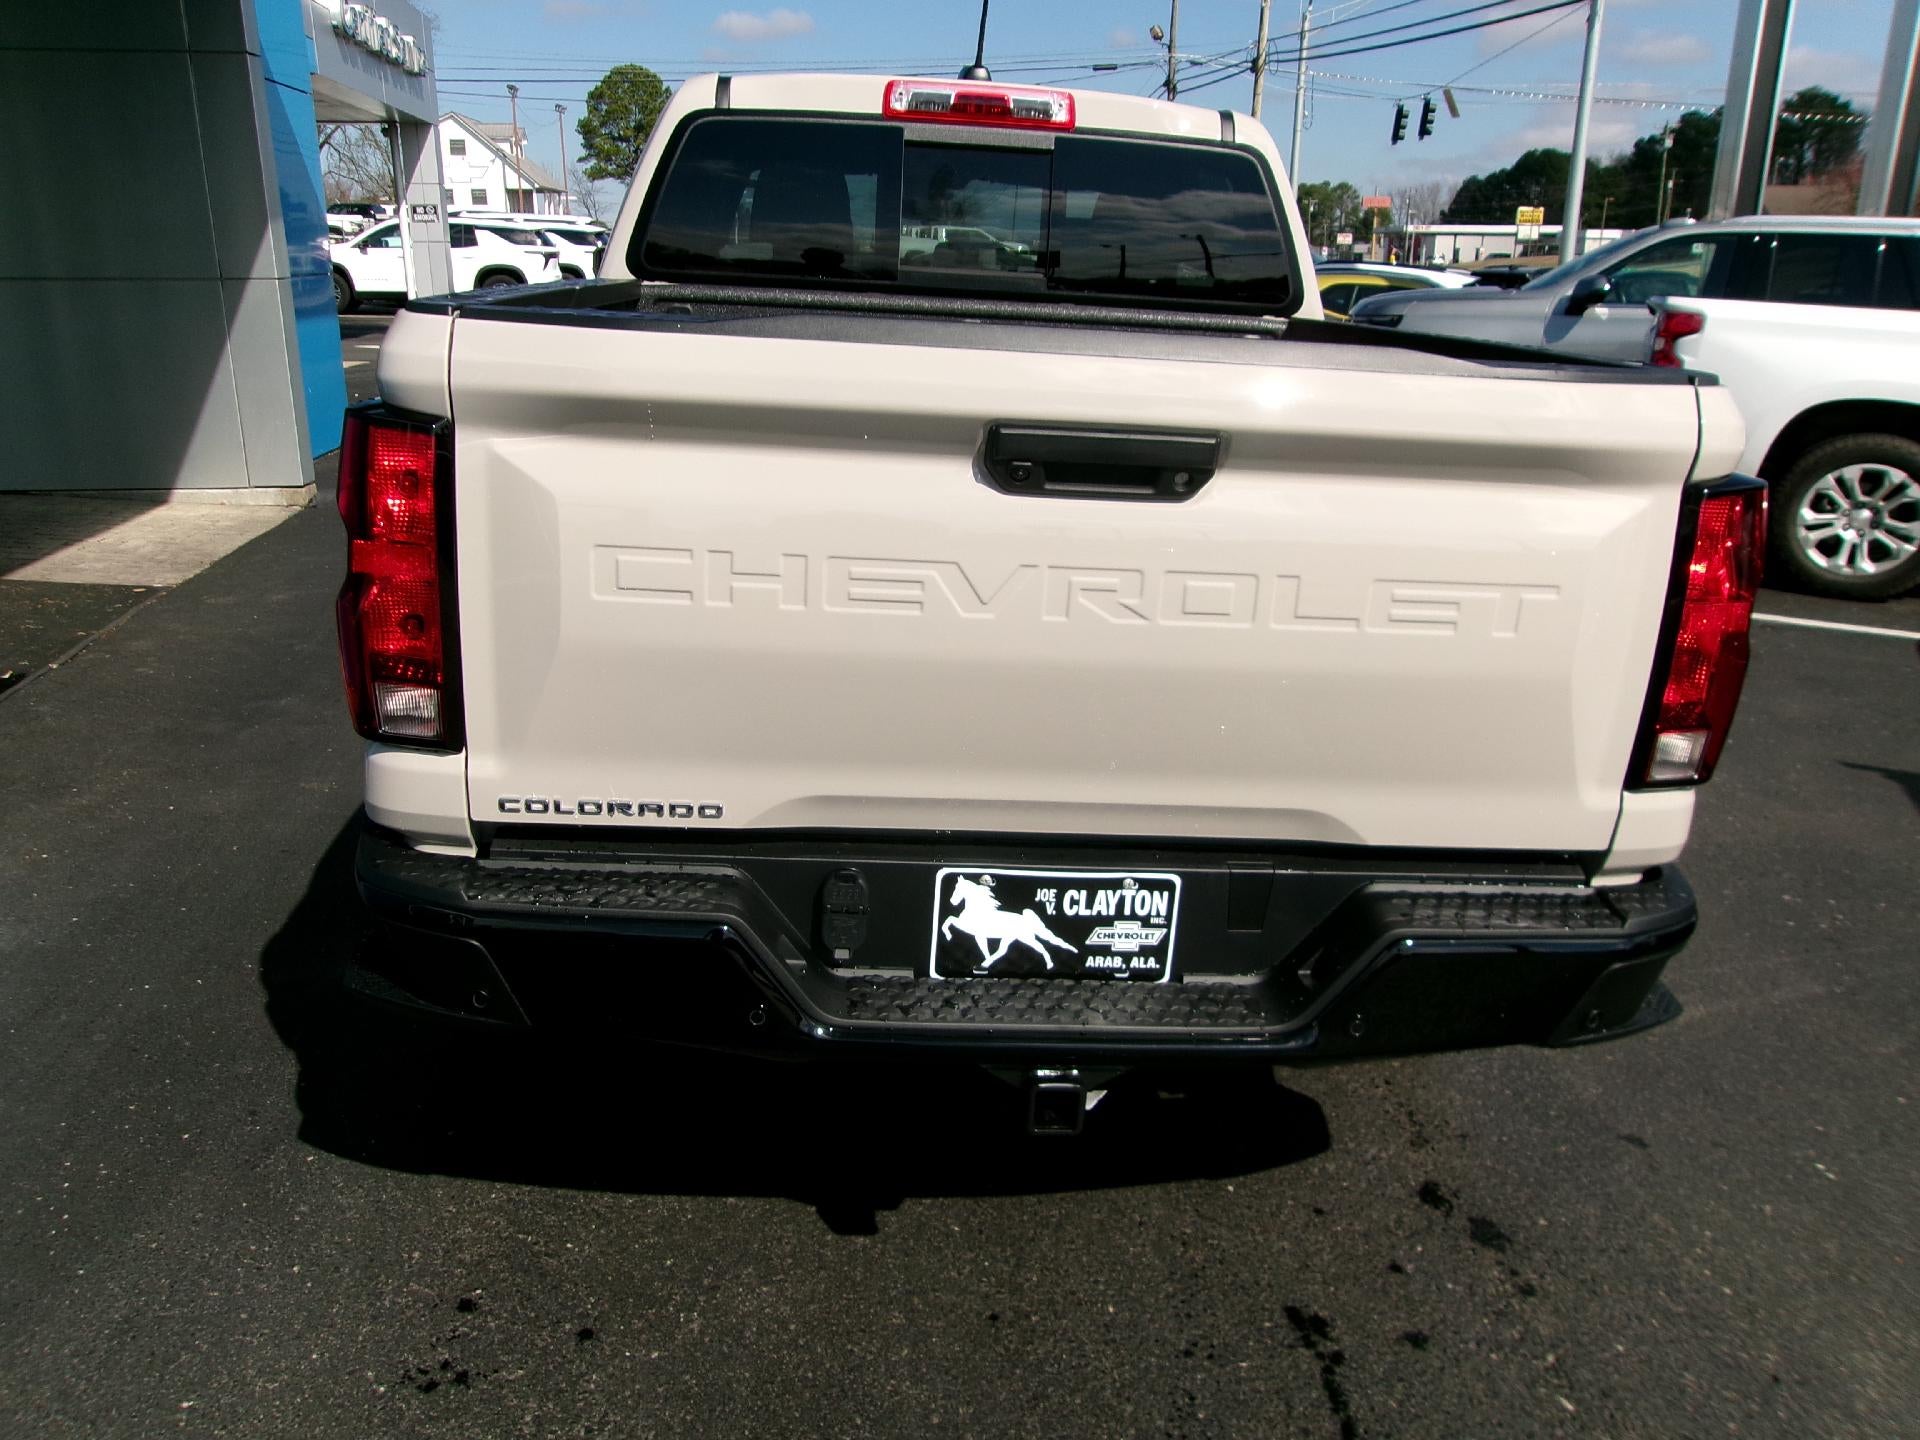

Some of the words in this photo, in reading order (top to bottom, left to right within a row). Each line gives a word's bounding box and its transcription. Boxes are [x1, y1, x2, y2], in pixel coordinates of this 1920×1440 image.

[590, 544, 1561, 638] CHEVROLET
[497, 796, 725, 819] COLORADO
[1035, 889, 1057, 901] JOE
[1045, 902, 1056, 915] V.
[1063, 889, 1169, 916] CLAYTON
[1150, 916, 1168, 924] INC.
[1096, 931, 1157, 941] CHEVROLET
[1085, 956, 1126, 970] ARAB,
[1130, 957, 1160, 969] ALA.
